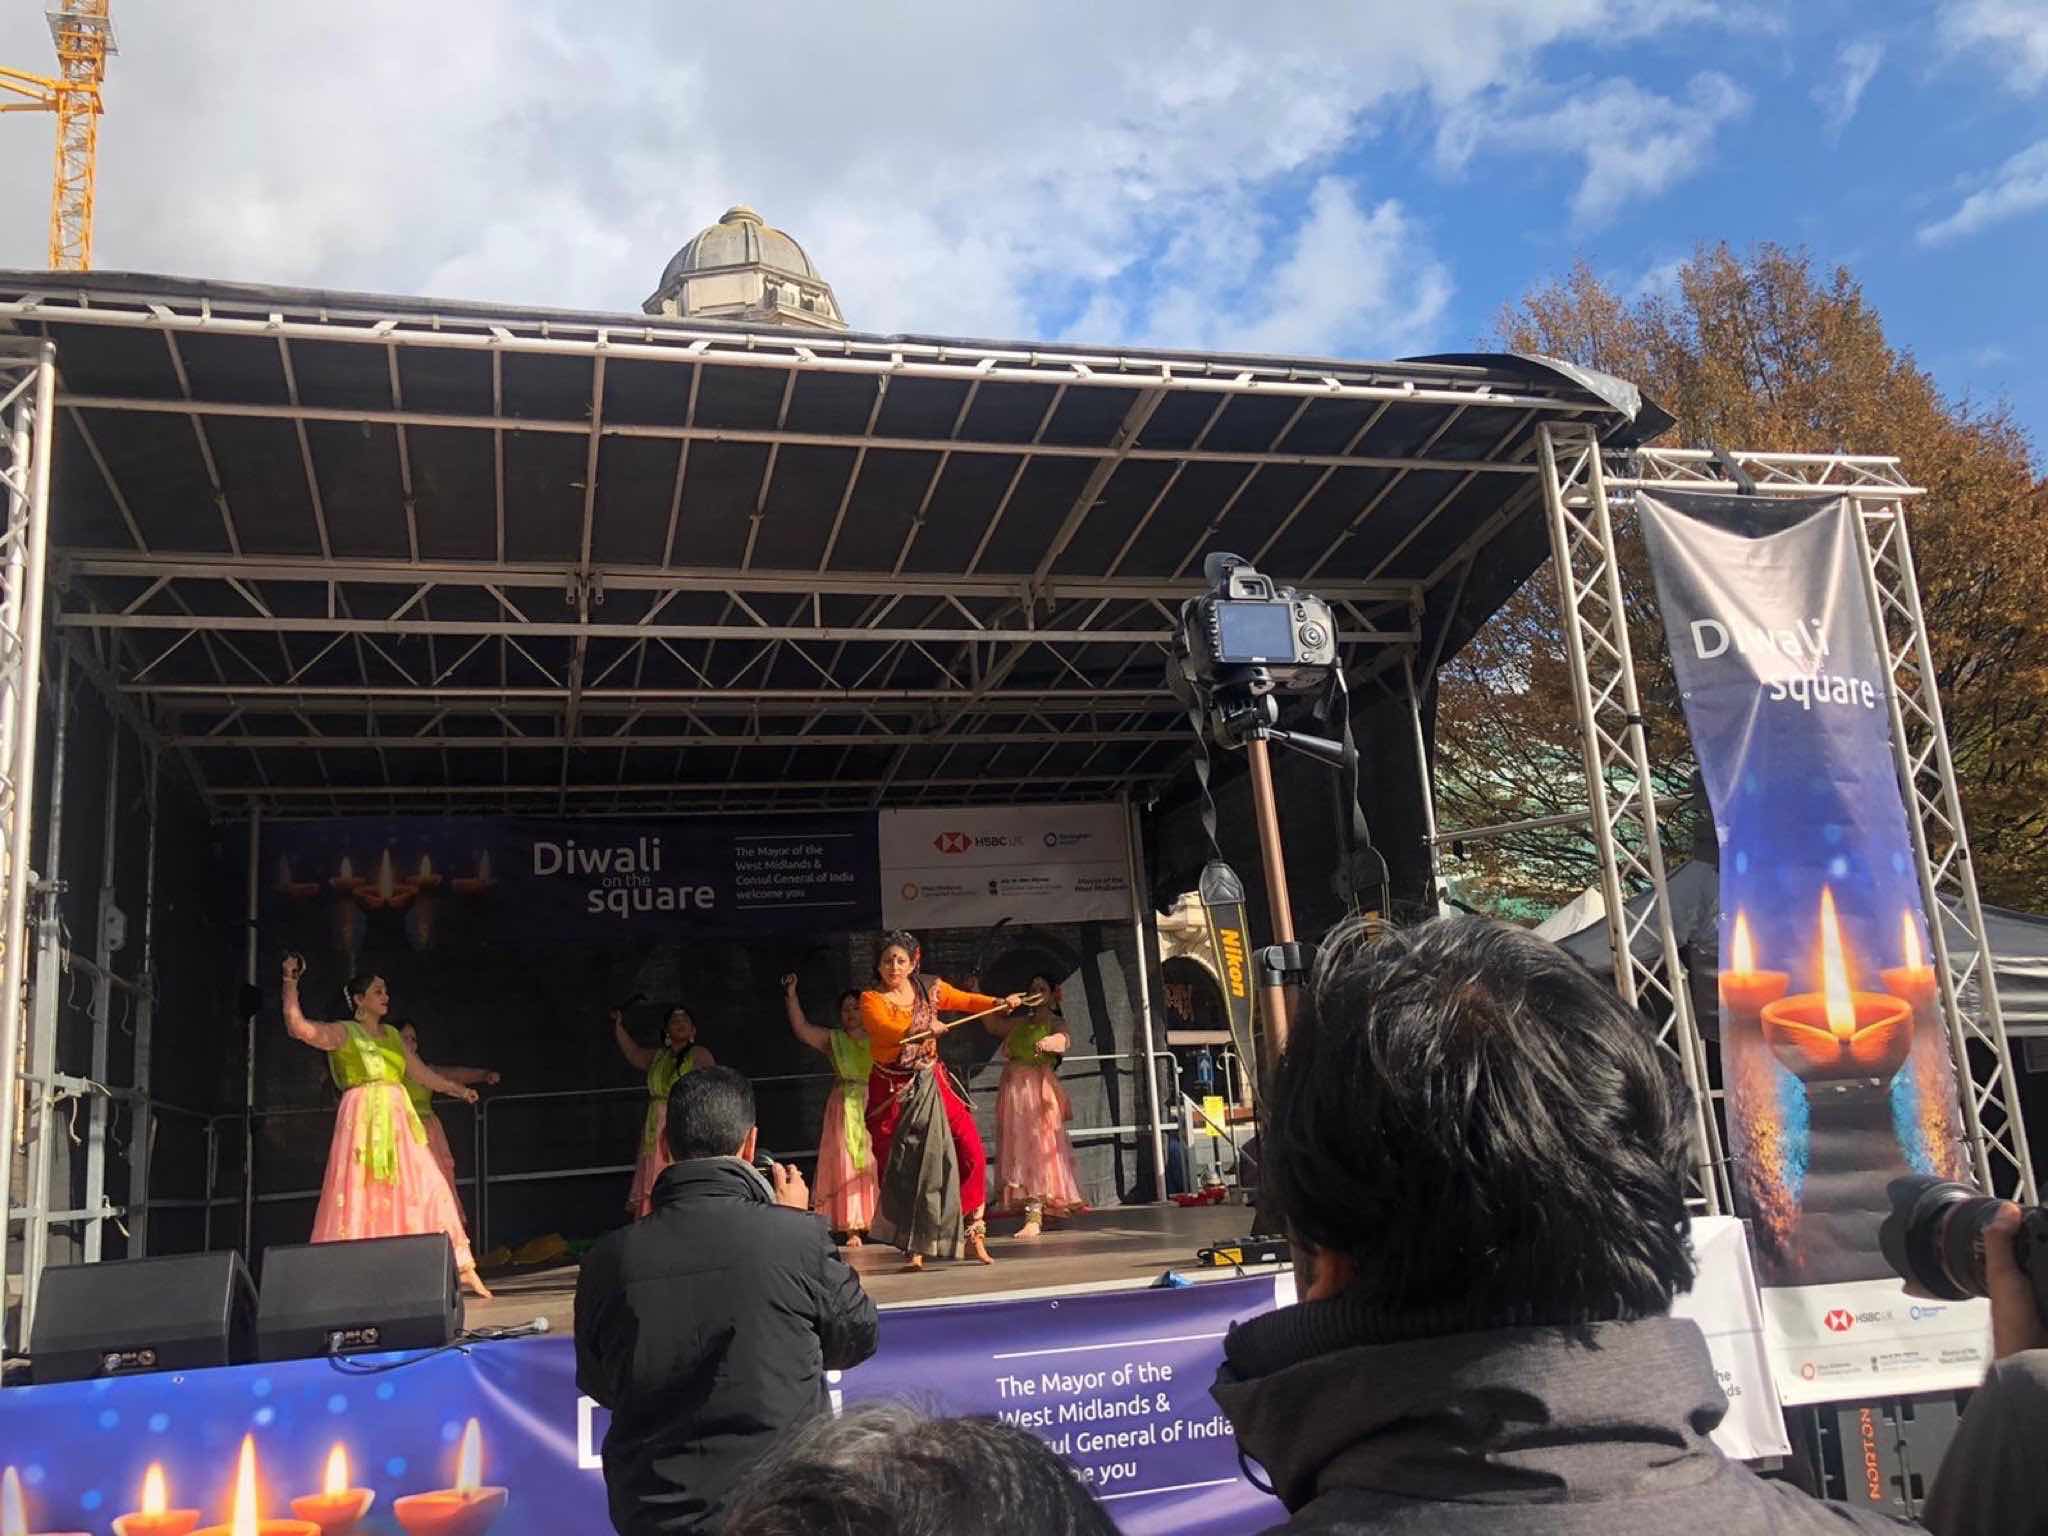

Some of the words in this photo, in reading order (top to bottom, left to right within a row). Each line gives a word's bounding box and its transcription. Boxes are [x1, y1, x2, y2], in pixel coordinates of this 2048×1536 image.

[1769, 674, 1875, 710] square
[533, 836, 662, 876] Diwali
[735, 847, 755, 857] The
[757, 847, 790, 857] Mayor
[792, 844, 803, 855] of
[805, 844, 824, 855] the
[975, 836, 1009, 848] HSBC
[602, 876, 623, 889] on
[625, 873, 651, 888] the
[816, 872, 828, 882] of
[586, 885, 716, 919] square
[1220, 928, 1245, 998] Nikon
[995, 1376, 1036, 1399] The
[1041, 1371, 1106, 1395] Mayor
[1111, 1363, 1133, 1387] of
[1138, 1362, 1173, 1384] the
[998, 1407, 1053, 1429] West
[1058, 1394, 1151, 1425] Midlands
[1155, 1392, 1171, 1413] &
[1076, 1423, 1156, 1452] General
[1161, 1419, 1183, 1443] of
[1188, 1417, 1234, 1440] India
[1099, 1461, 1137, 1485] you
